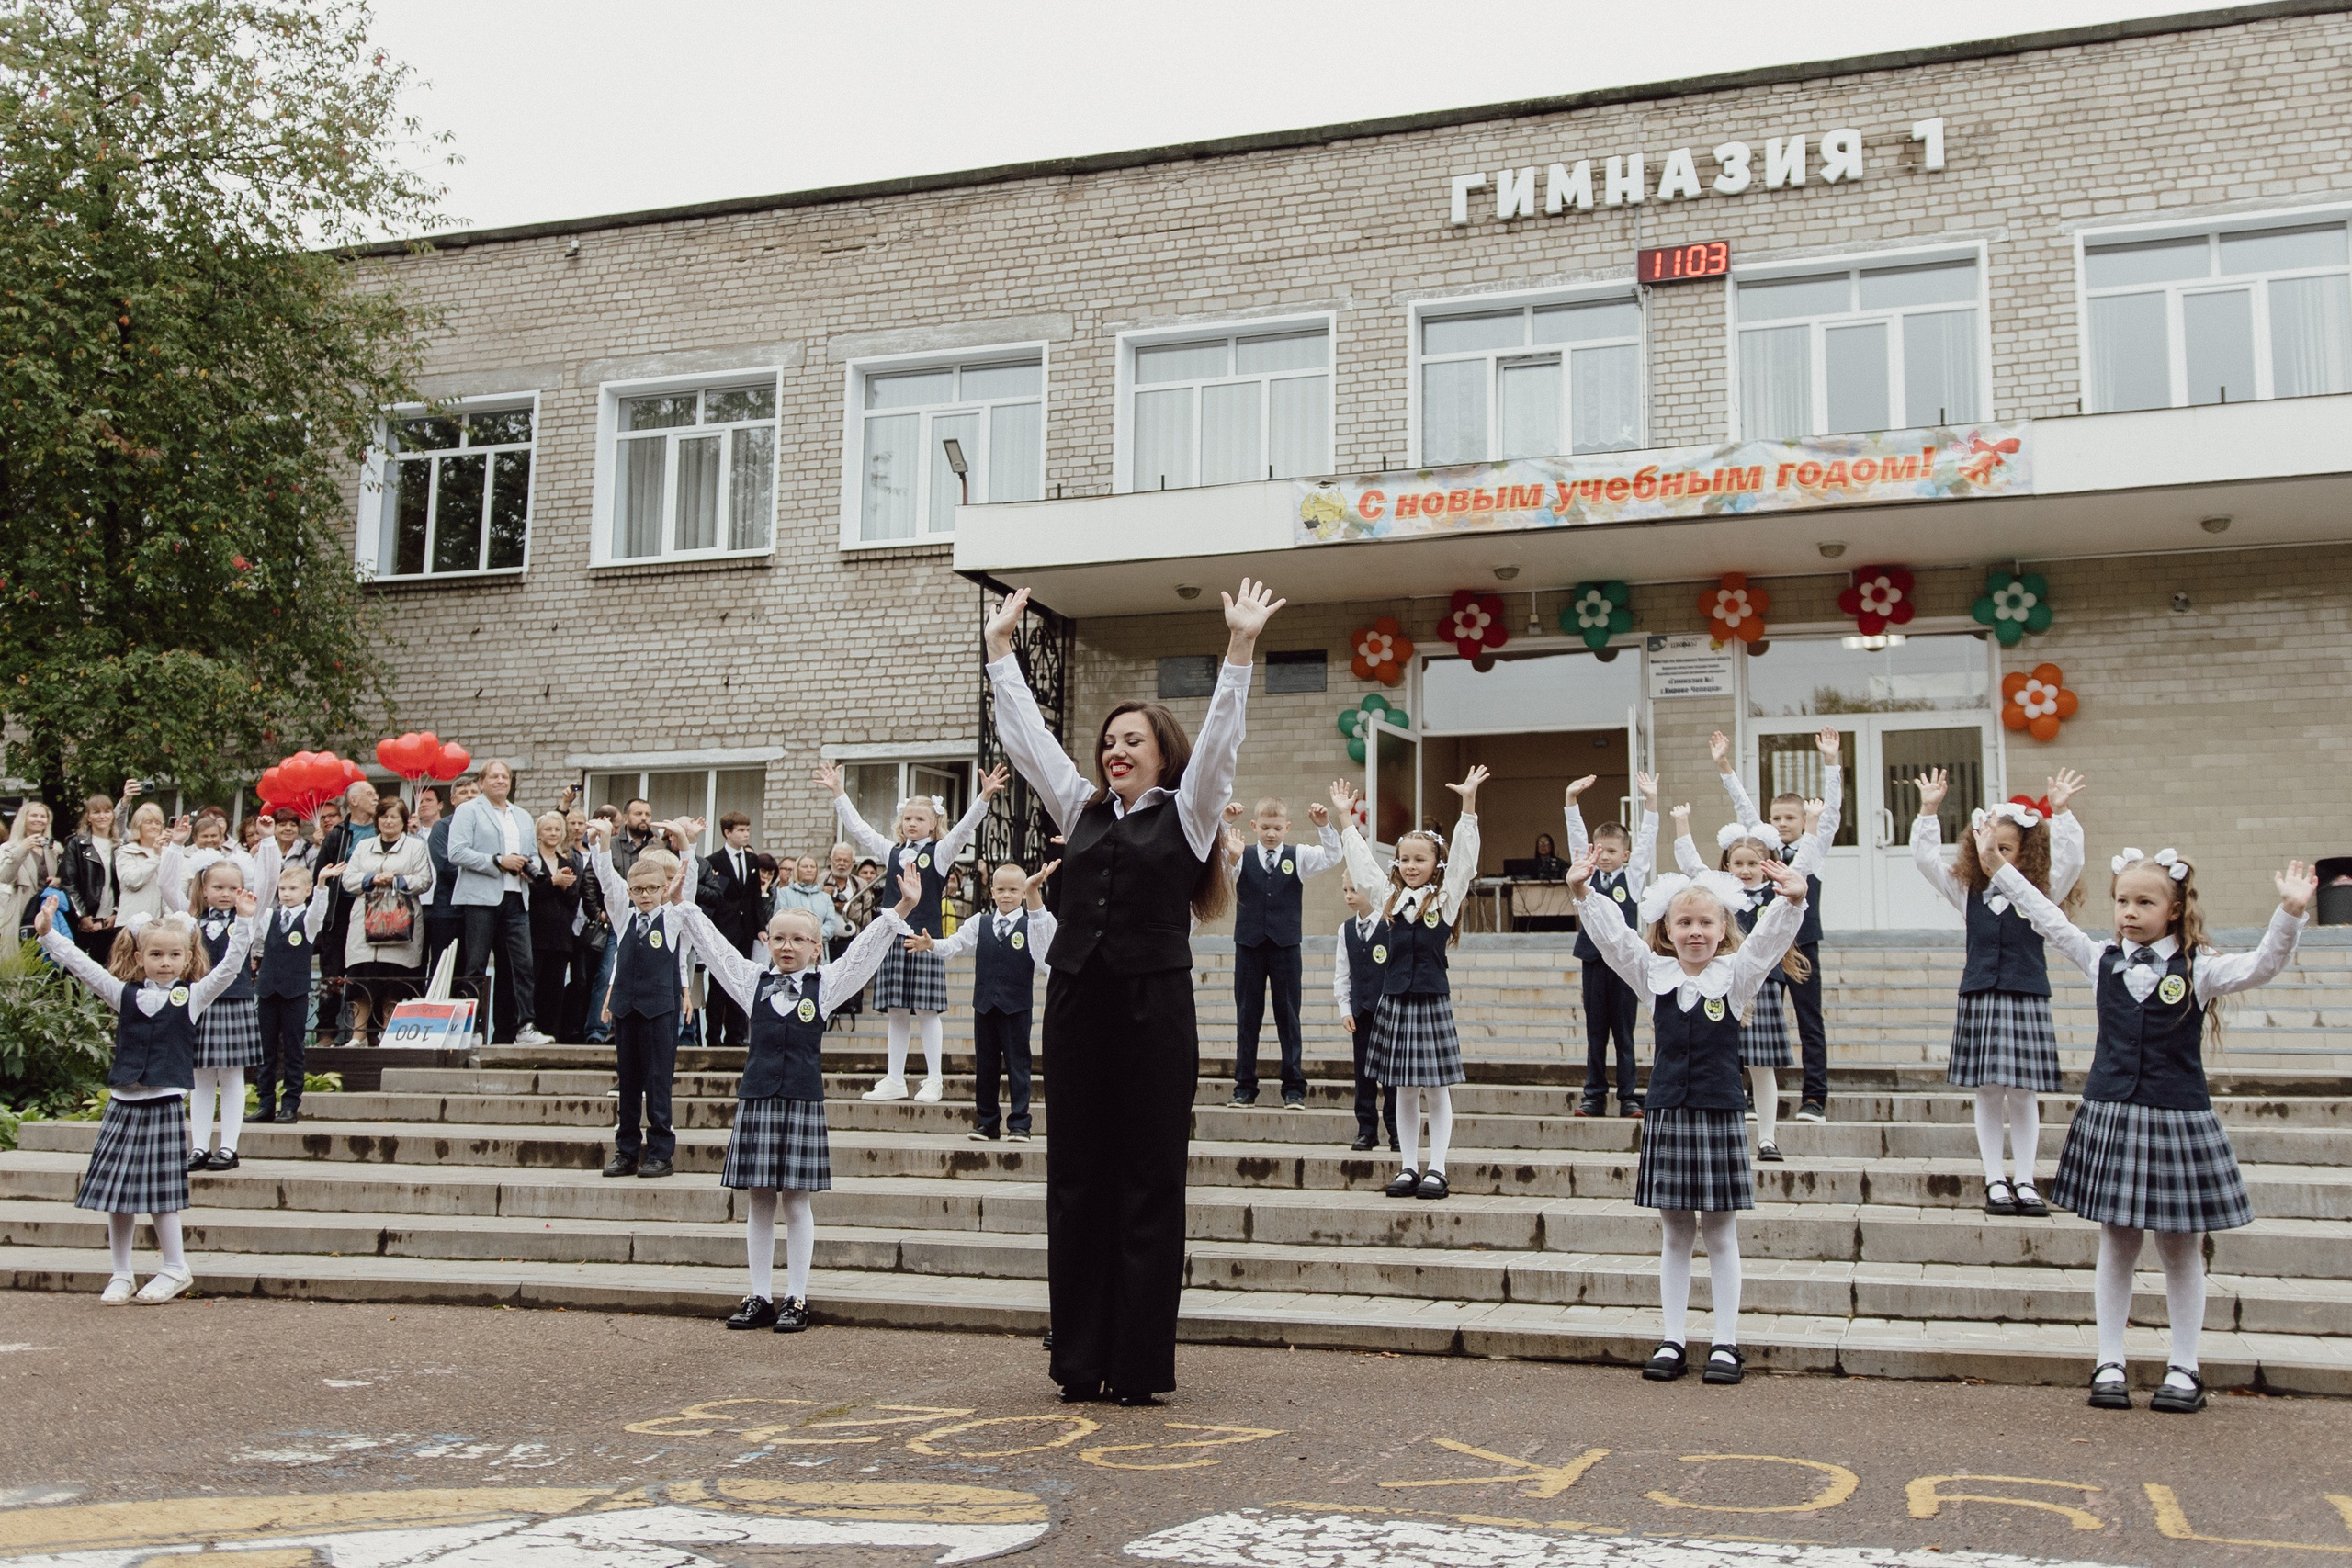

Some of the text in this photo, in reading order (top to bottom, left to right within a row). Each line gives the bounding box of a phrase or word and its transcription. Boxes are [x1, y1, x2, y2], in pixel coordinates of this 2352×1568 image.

[1451, 117, 1945, 225] ГИМНАЗИЯ 1
[1356, 446, 1938, 521] С новым учебным годом!
[395, 1024, 433, 1042] 100
[623, 1398, 1285, 1471] 2023
